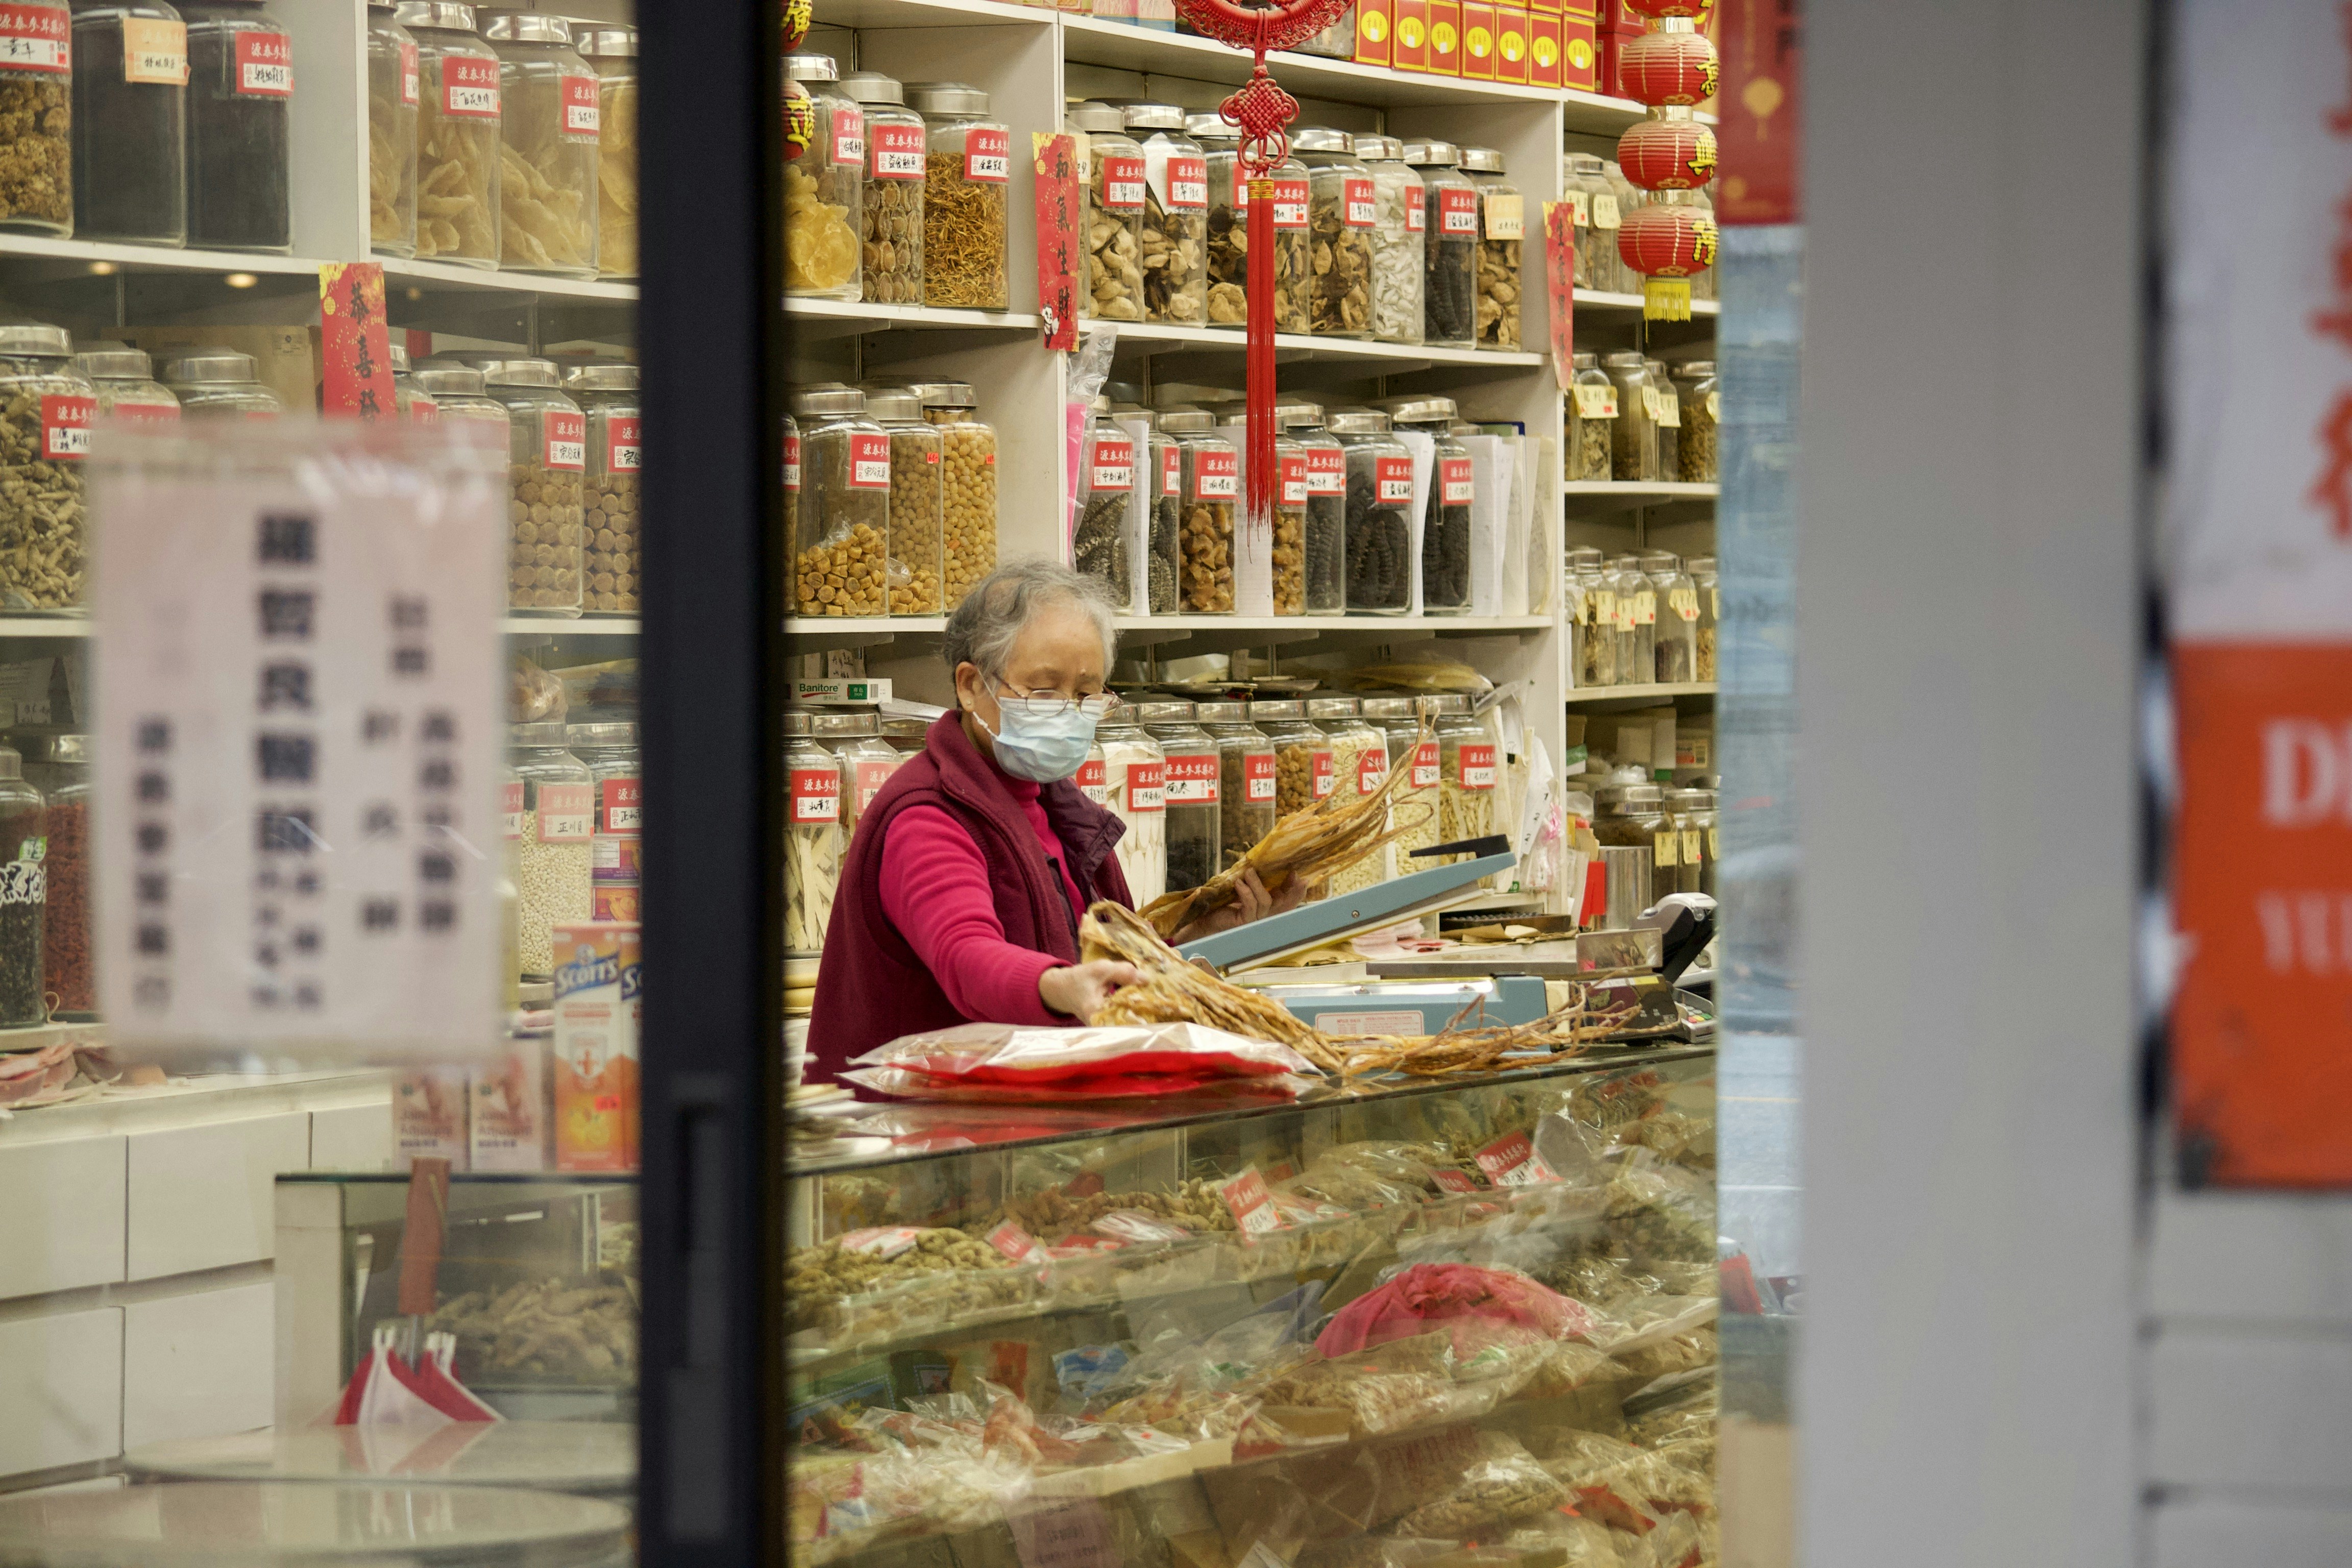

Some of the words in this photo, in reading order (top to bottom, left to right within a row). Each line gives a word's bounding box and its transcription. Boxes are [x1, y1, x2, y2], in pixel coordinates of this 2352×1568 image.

[1055, 152, 1070, 321] 和氣生財
[799, 683, 839, 692] Banitore
